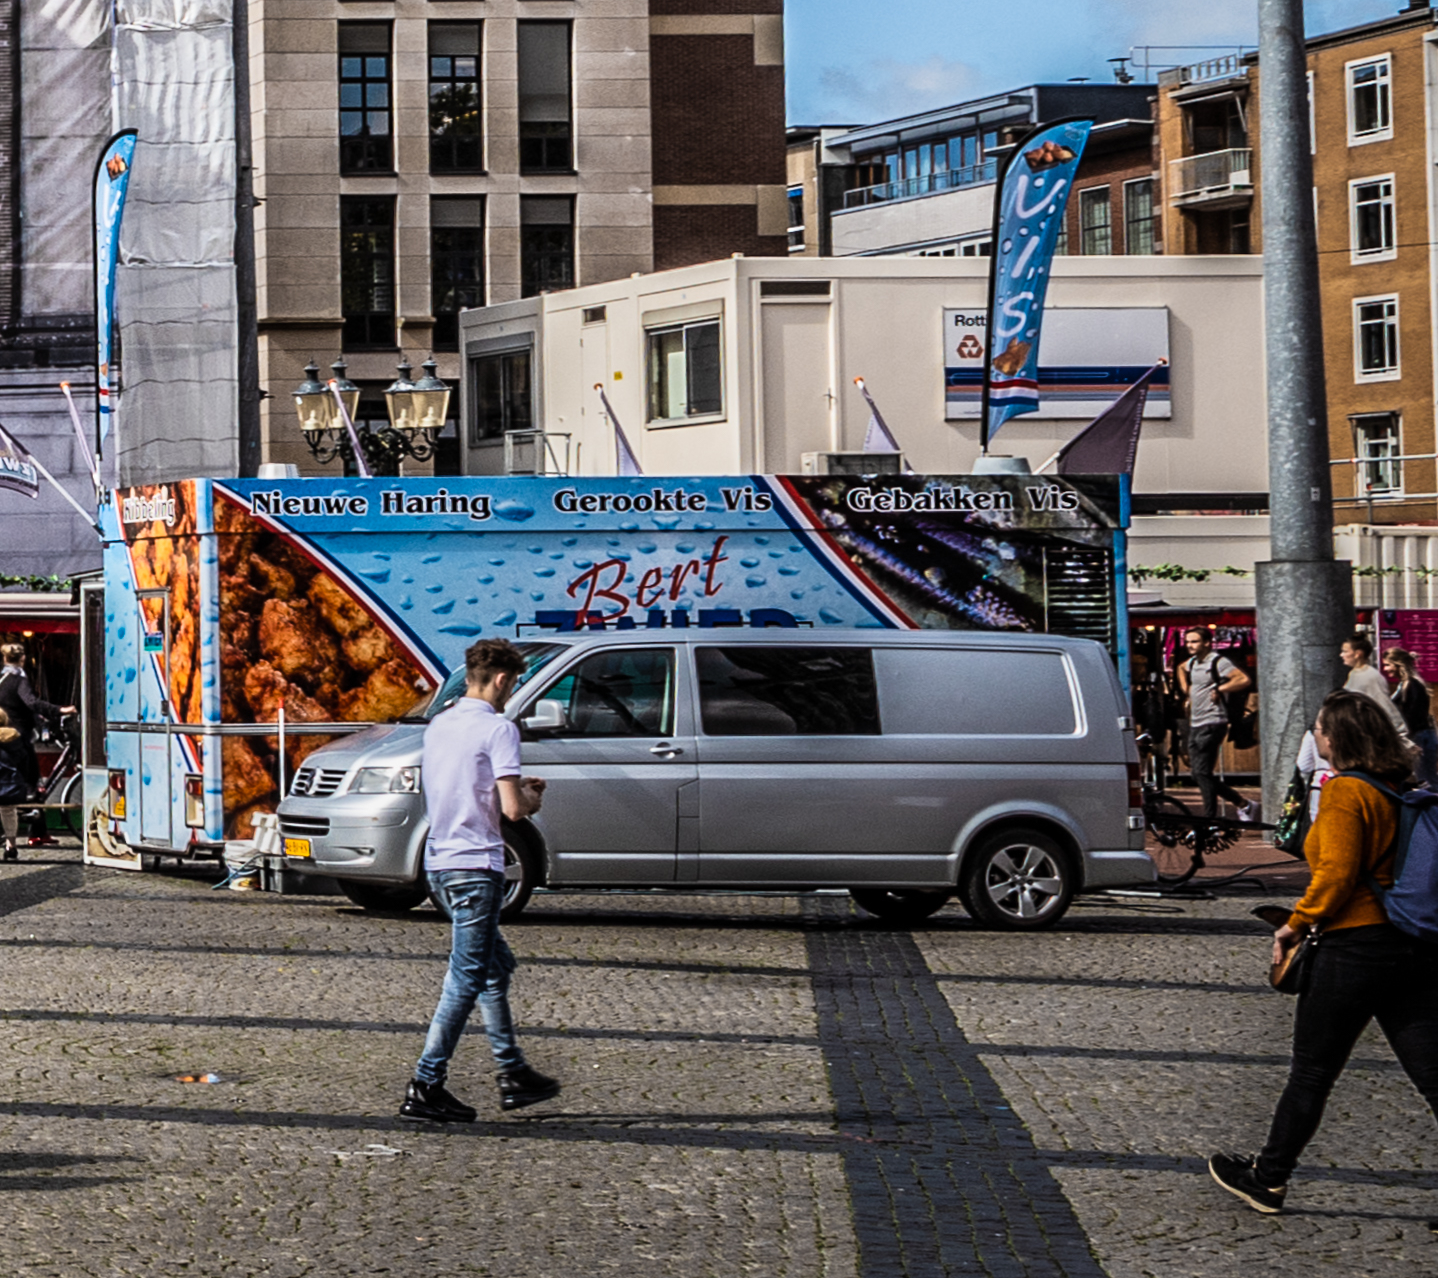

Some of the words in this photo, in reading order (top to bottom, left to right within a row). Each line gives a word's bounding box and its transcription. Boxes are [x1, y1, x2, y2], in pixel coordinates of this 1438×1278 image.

[123, 494, 176, 527] Kibbeling
[250, 488, 368, 516] Nieuwe
[380, 486, 492, 521] Haring
[553, 487, 706, 513] Gerookte
[721, 486, 773, 512] Vis
[847, 486, 1015, 513] Gebakken
[1025, 484, 1080, 512] Vis
[566, 535, 730, 627] Bert
